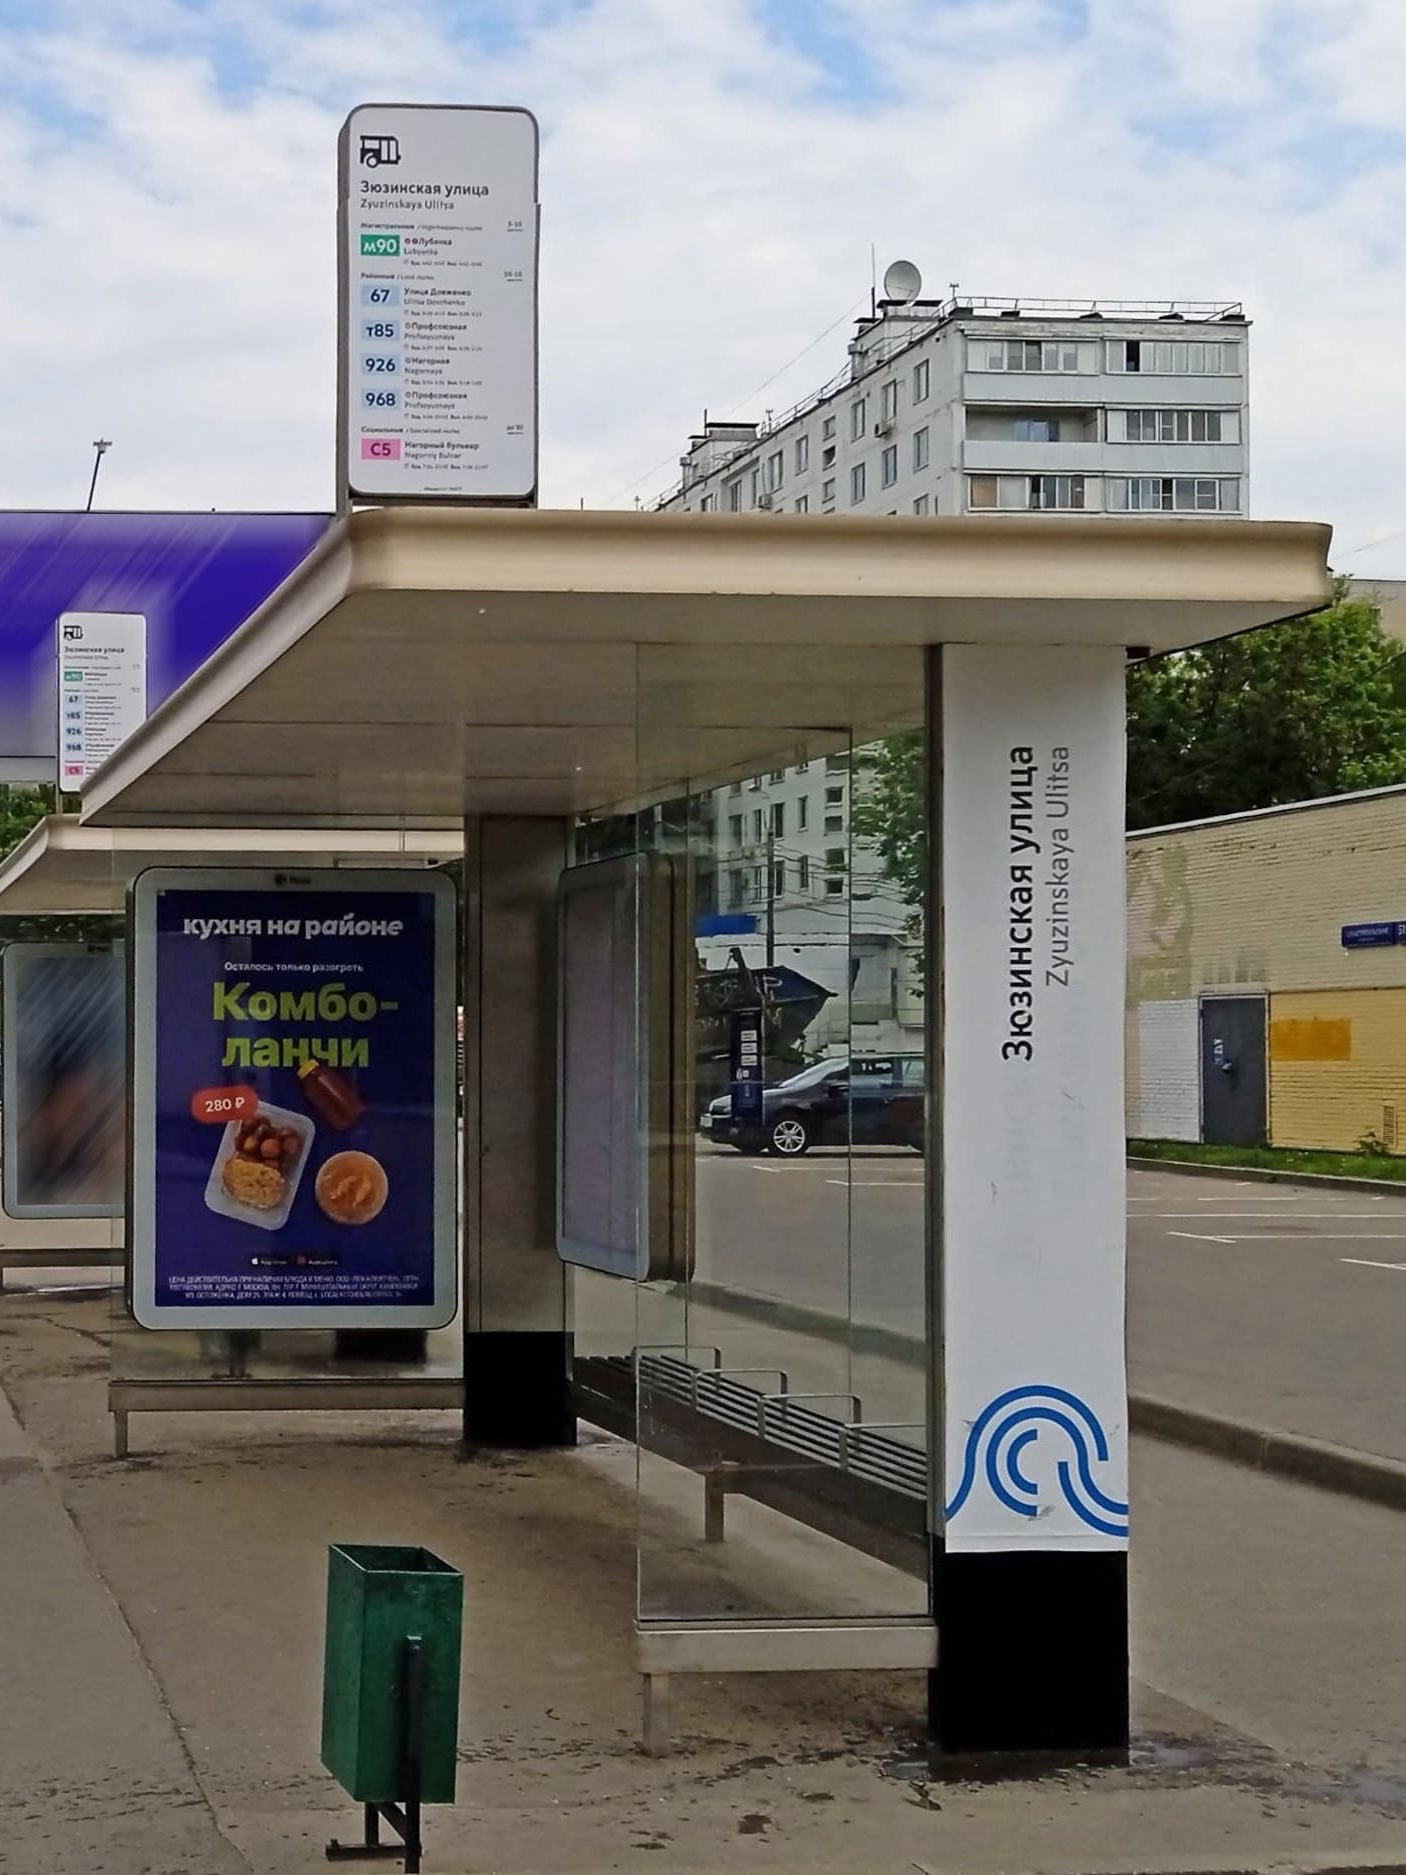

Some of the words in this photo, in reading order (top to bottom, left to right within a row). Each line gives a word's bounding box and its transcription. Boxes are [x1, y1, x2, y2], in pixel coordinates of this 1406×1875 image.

[360, 180, 441, 195] Зюзинская
[444, 184, 489, 198] улица
[360, 199, 422, 211] Zyuzinskaya
[425, 200, 455, 211] Ulitsa
[363, 238, 397, 253] м90
[370, 289, 390, 303] 67
[404, 287, 428, 297] Улица
[366, 323, 394, 337] т85
[411, 322, 467, 331] Профсоюзная
[365, 358, 396, 372] 926
[411, 357, 450, 365] Нагорная
[365, 392, 396, 407] 968
[411, 391, 467, 400] Профсоюзная
[370, 442, 392, 456] С5
[405, 441, 445, 449] Нагорный
[446, 441, 479, 450] бульвар
[1044, 746, 1069, 818] Ulitsa
[1009, 745, 1041, 855] улица
[1044, 828, 1074, 986] Zyuzinskaya
[183, 918, 262, 940] кухня
[267, 918, 300, 935] на
[305, 912, 404, 940] районе
[224, 961, 274, 971] Осталось
[275, 963, 311, 971] только
[312, 964, 364, 974] разогреть
[1001, 865, 1034, 1062] Зюзинская
[212, 981, 399, 1021] Комбо-
[221, 1037, 370, 1068] ланчи
[205, 1099, 232, 1113] 280
